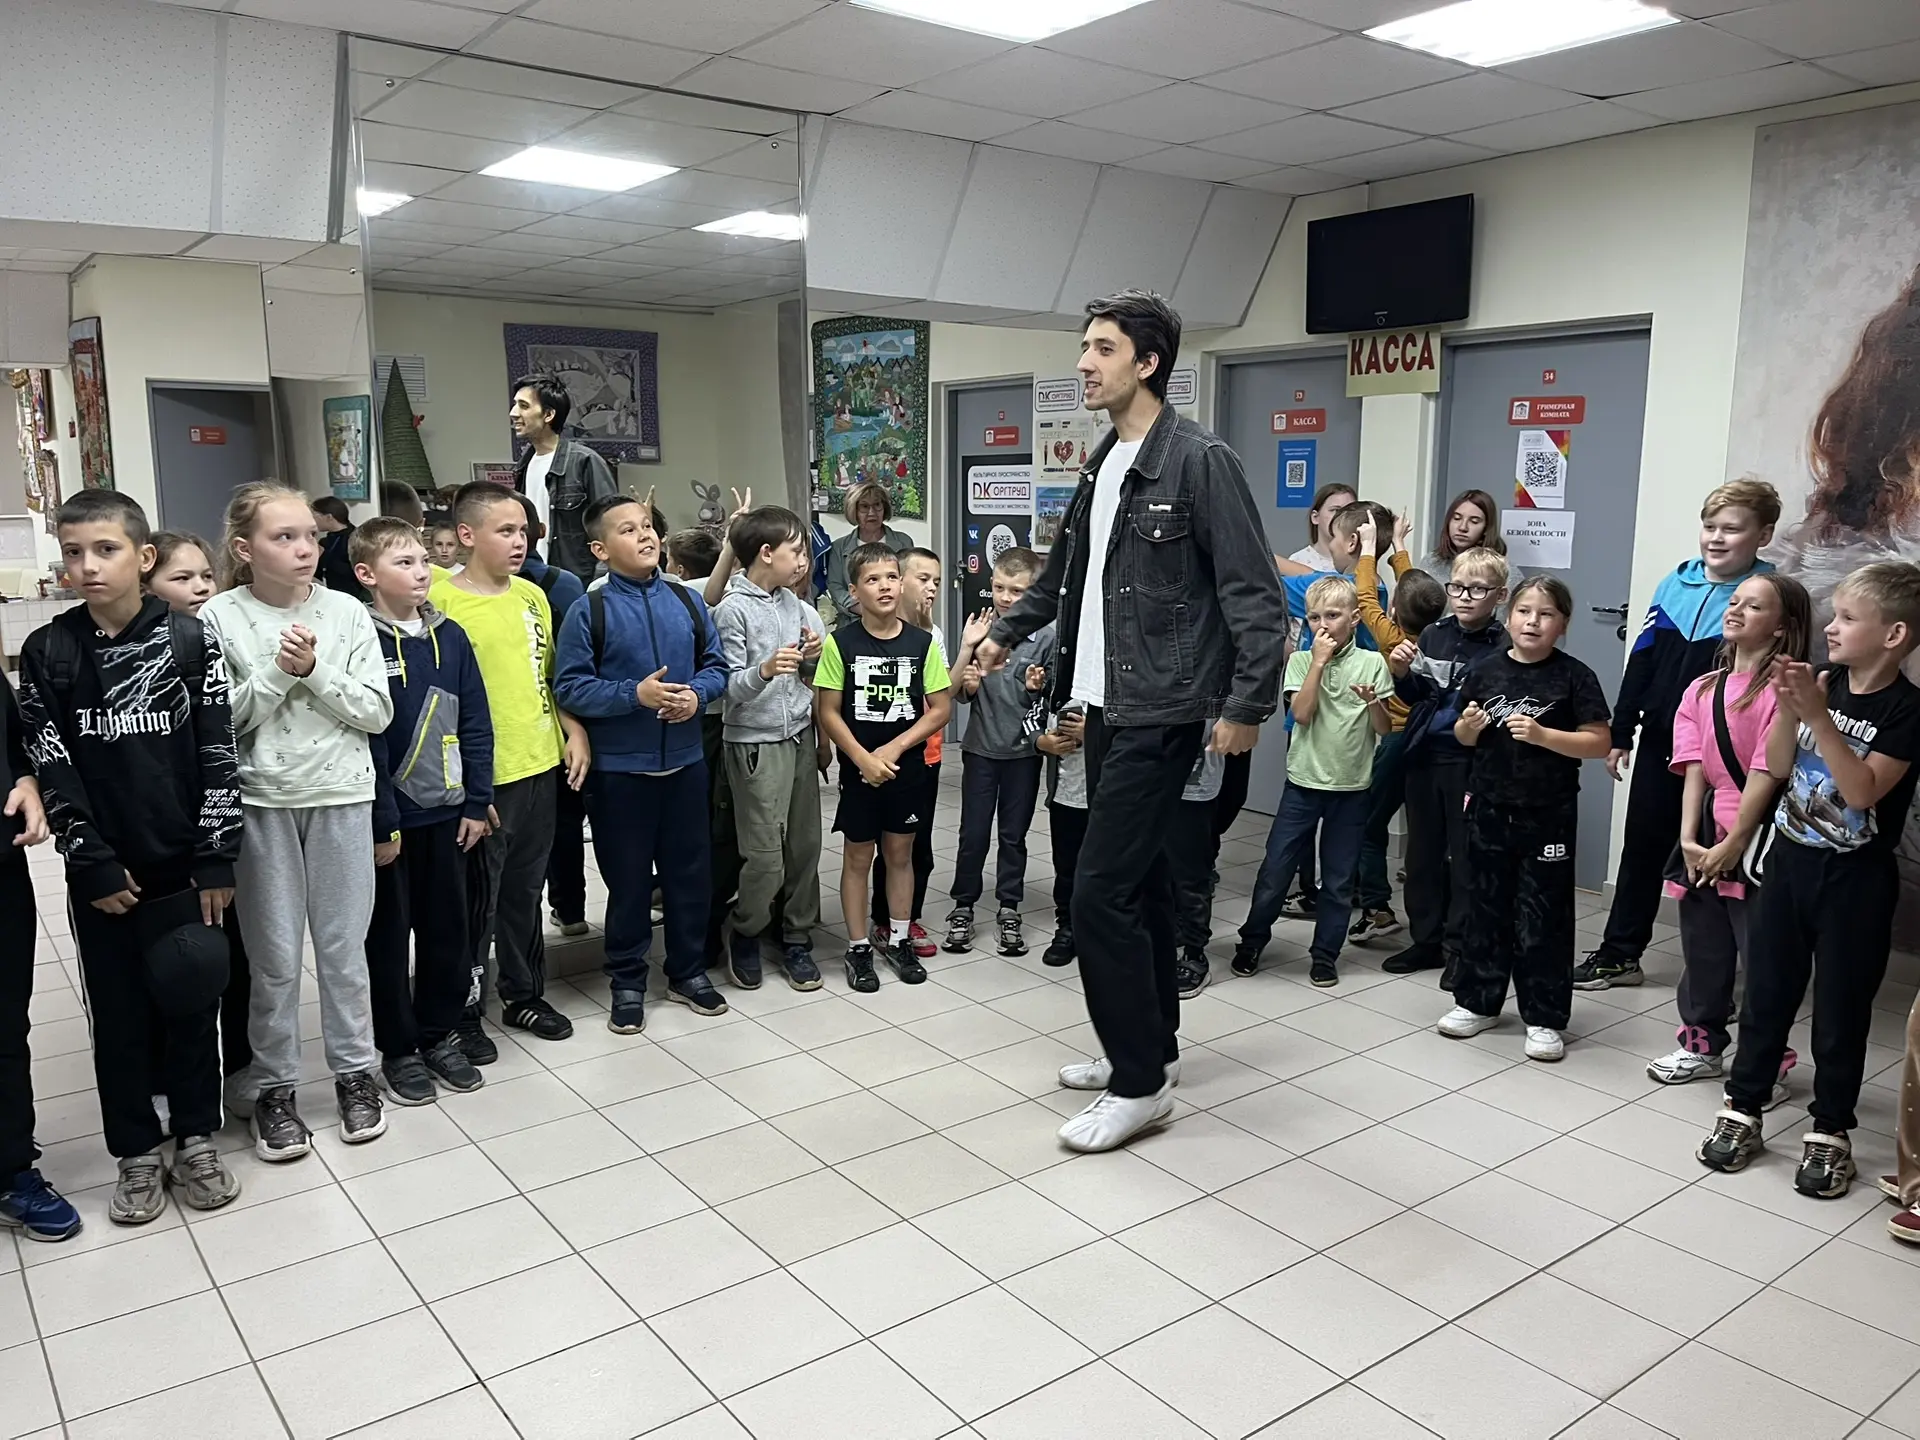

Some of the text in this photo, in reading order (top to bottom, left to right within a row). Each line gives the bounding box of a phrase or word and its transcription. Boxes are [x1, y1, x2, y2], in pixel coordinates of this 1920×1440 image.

[1350, 331, 1435, 376] КАССА
[1544, 372, 1554, 381] 34
[1536, 403, 1576, 411] ГРИМЕРНАЯ
[1293, 417, 1317, 426] КАССА
[973, 482, 1027, 500] DK ОРГТРУД
[1527, 520, 1547, 528] ЗОНА
[1506, 529, 1567, 538] БЕЗОПАСНОСТИ
[1529, 539, 1541, 547] №2
[863, 683, 907, 703] PRO
[76, 707, 172, 743] Lightning
[200, 807, 243, 817] OMETHIN
[198, 817, 224, 828] NEW
